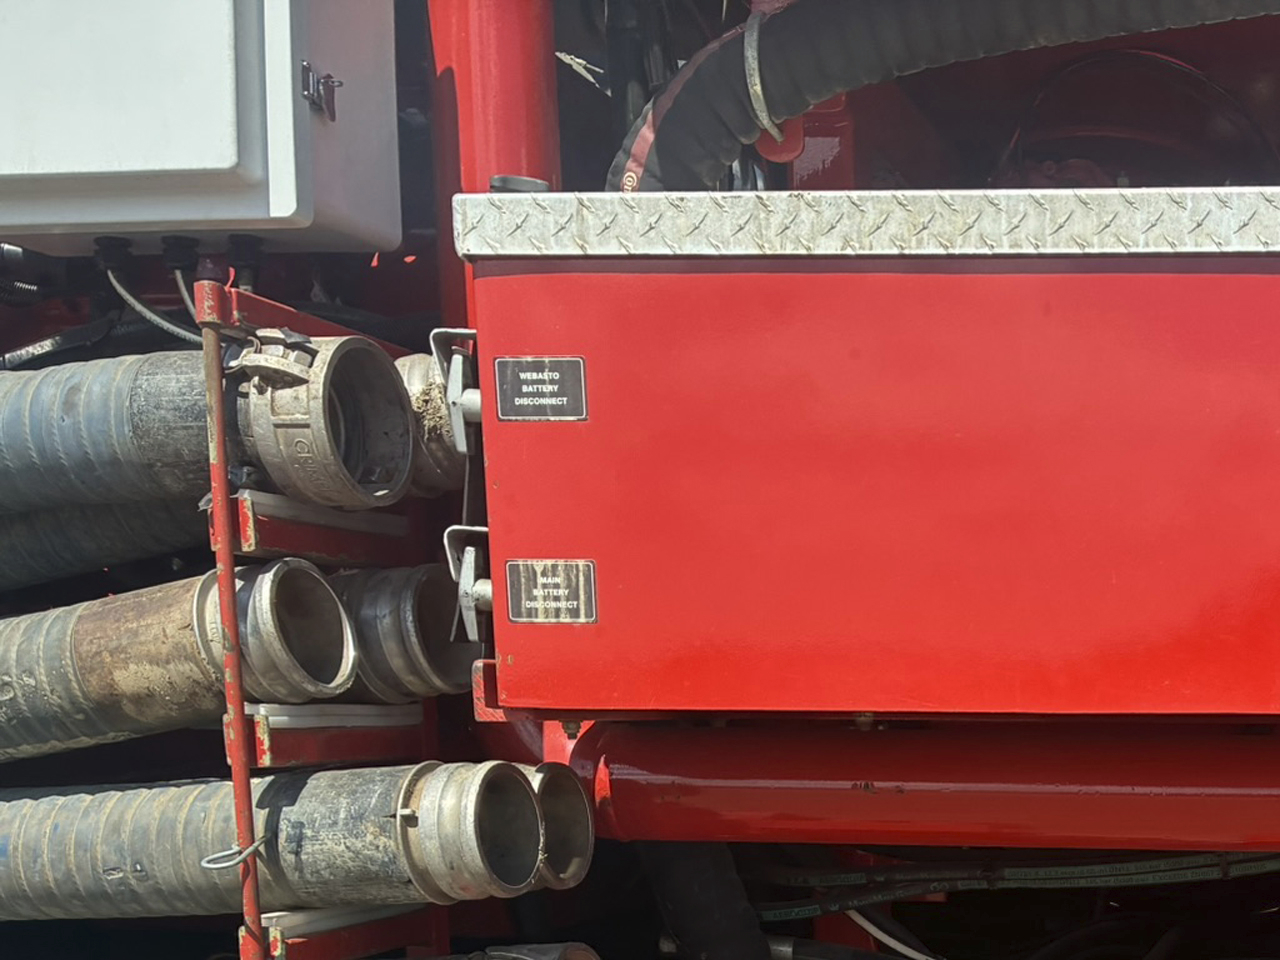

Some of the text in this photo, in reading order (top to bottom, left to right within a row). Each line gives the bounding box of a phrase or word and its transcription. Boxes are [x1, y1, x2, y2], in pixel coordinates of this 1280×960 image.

[519, 372, 560, 380] WEBASTO
[514, 397, 568, 405] DISCONNECT
[539, 576, 561, 584] MAIN
[532, 588, 569, 596] BATTERY
